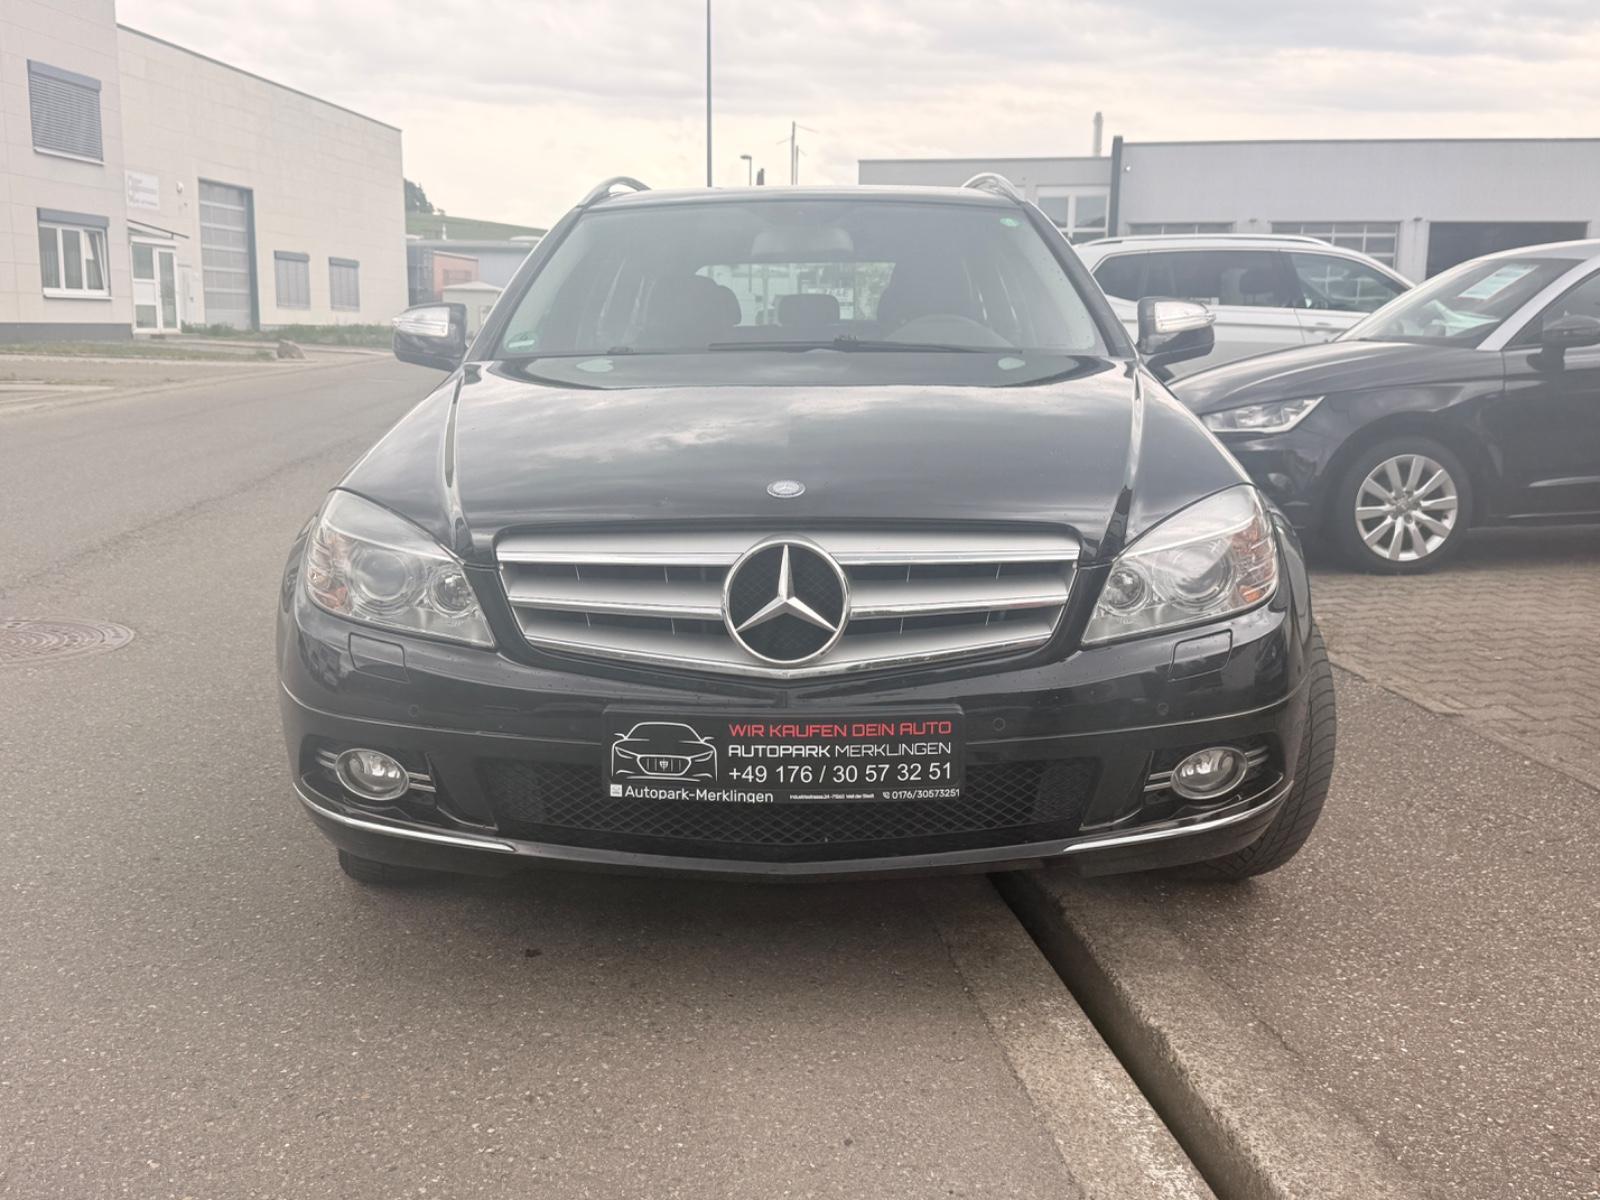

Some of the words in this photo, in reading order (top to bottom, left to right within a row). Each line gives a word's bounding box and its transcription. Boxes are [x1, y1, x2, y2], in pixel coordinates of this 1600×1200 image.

[728, 723, 765, 737] WIR
[768, 723, 848, 738] KAUFEN
[851, 722, 895, 737] DEIN
[899, 721, 952, 736] AUTO
[728, 744, 831, 758] AUTOPARK
[835, 742, 952, 758] MERKLINGEN
[728, 765, 768, 783] +49
[775, 765, 813, 784] 176
[818, 765, 827, 784] /
[832, 764, 858, 783] 30
[865, 763, 890, 783] 57
[896, 762, 922, 782] 32
[928, 761, 951, 780] 51
[624, 785, 774, 804] Autopark-Merklingen
[892, 788, 960, 800] 0176/30573251
